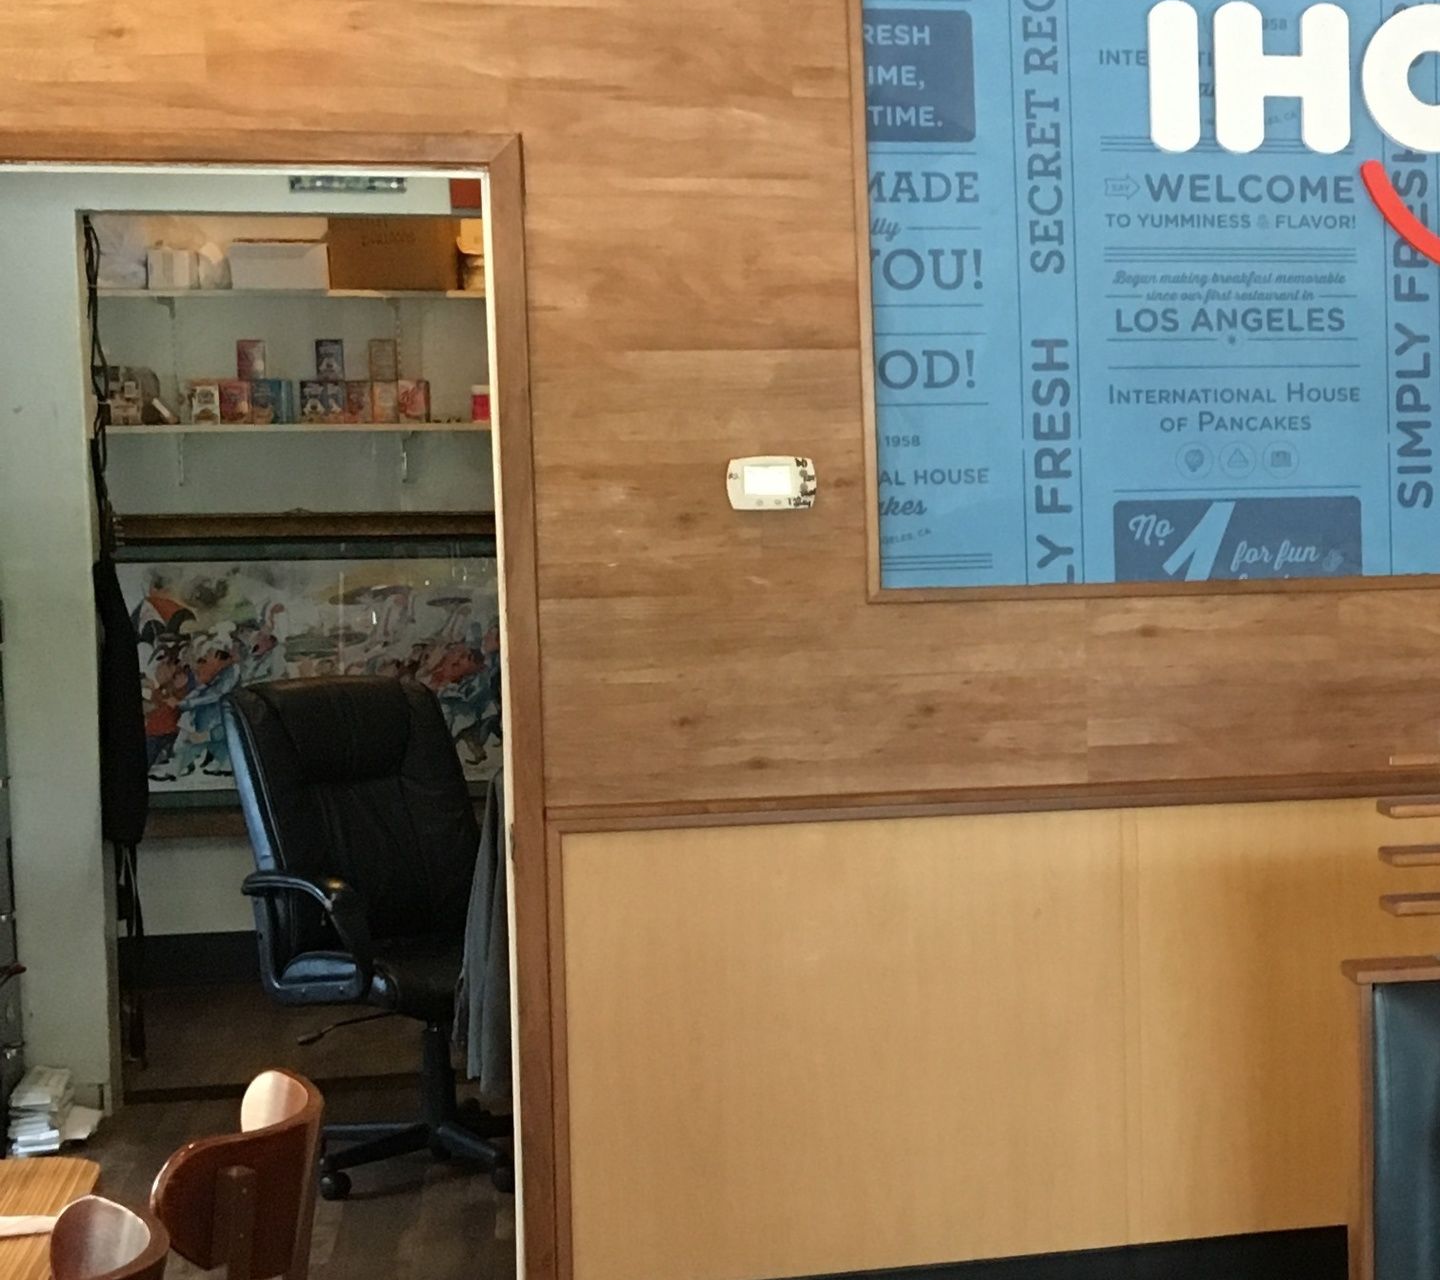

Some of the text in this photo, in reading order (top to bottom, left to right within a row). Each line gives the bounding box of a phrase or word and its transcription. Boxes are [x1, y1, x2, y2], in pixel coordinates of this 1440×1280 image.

[867, 106, 944, 128] TIME.
[1025, 89, 1065, 274] SECRET
[1145, 173, 1355, 204] WELCOME
[1105, 214, 1131, 229] TO
[1137, 214, 1251, 229] YUMMINESS
[1275, 215, 1356, 230] FLAVOR!
[1159, 271, 1208, 288] making
[1211, 270, 1272, 287] breakfast
[1275, 271, 1347, 284] memorable
[1146, 289, 1178, 301] since
[1203, 289, 1232, 304] first
[1235, 290, 1299, 302] restaurant
[1302, 289, 1315, 301] in
[1115, 306, 1346, 333] LOS ANGELES
[1031, 339, 1073, 514] FRESH
[1395, 322, 1433, 508] SIMPLY
[885, 435, 921, 448] 1958
[914, 468, 989, 486] HOUSE
[1230, 540, 1274, 572] for
[1273, 539, 1320, 571] fun
